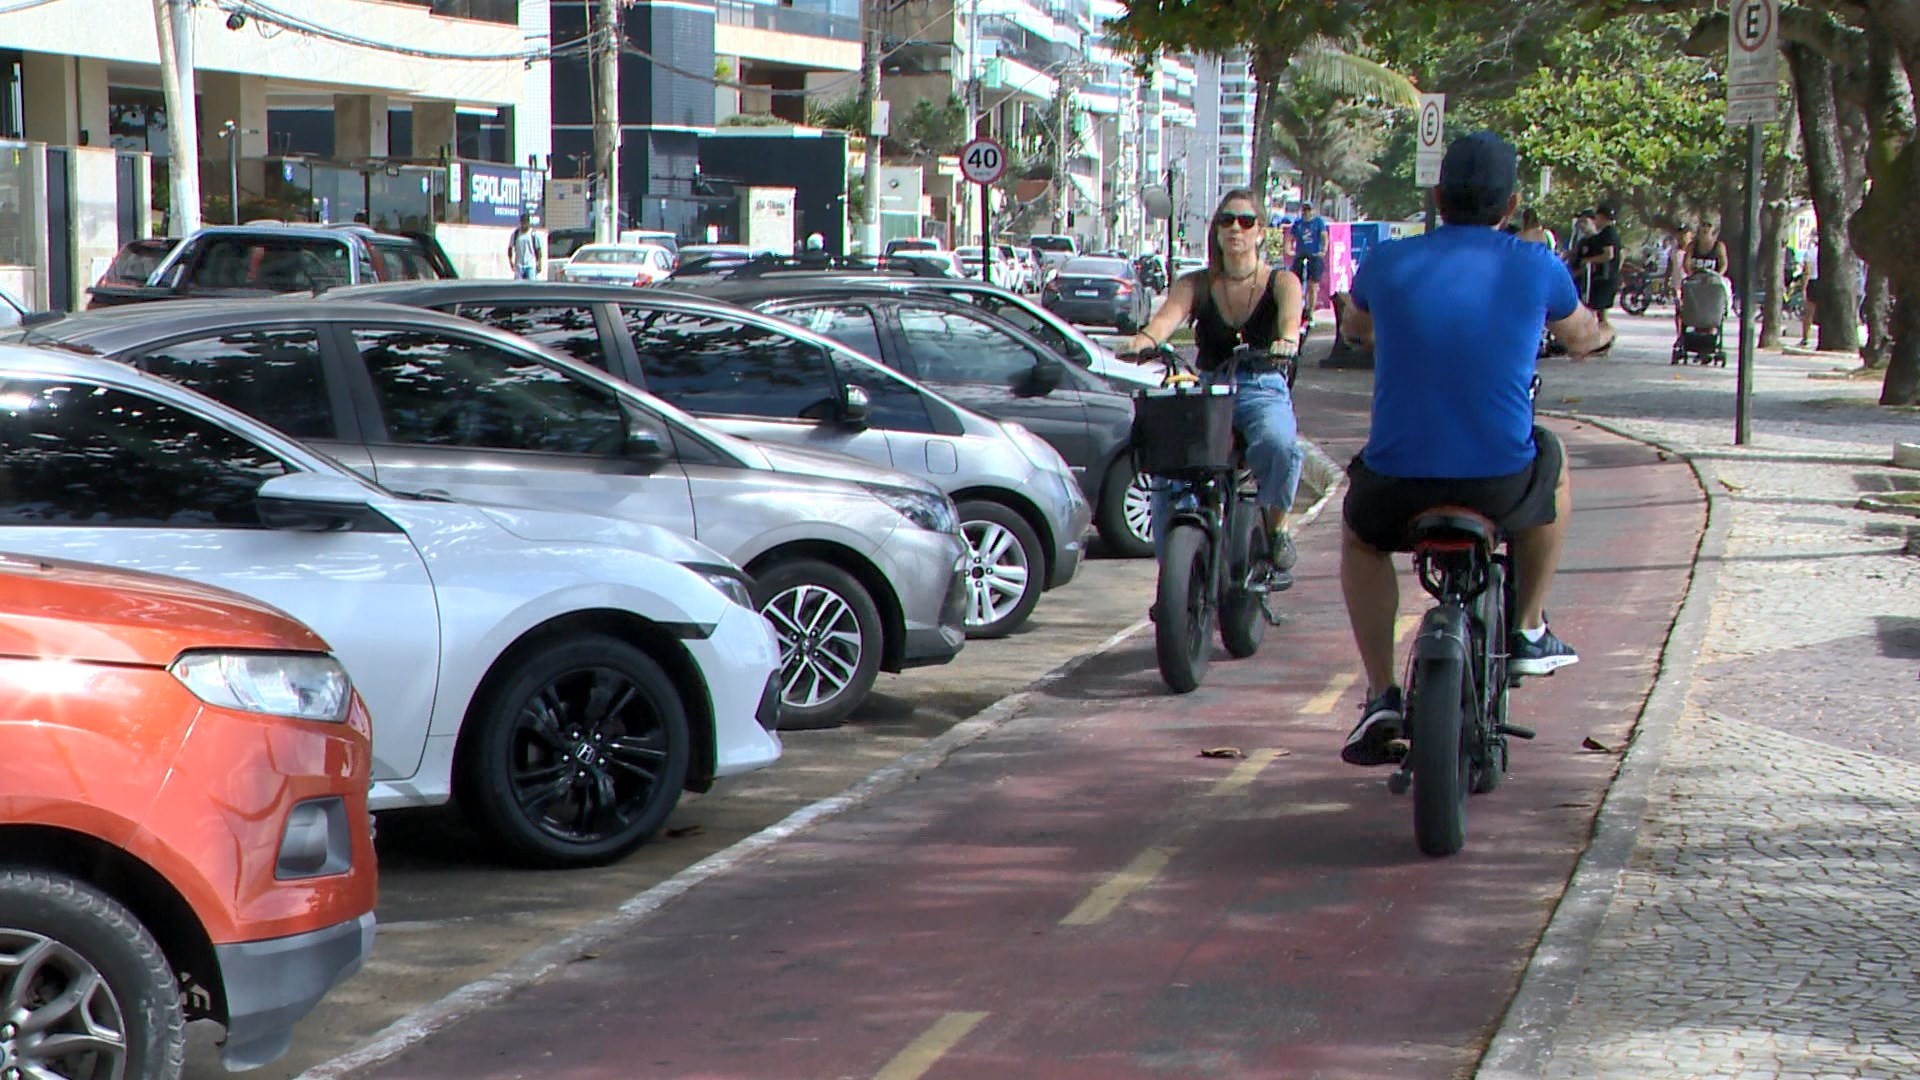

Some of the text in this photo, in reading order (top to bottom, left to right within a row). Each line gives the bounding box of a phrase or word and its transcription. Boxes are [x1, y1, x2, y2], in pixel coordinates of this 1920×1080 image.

[1746, 4, 1761, 39] E
[1426, 111, 1434, 137] E
[967, 147, 998, 169] 40
